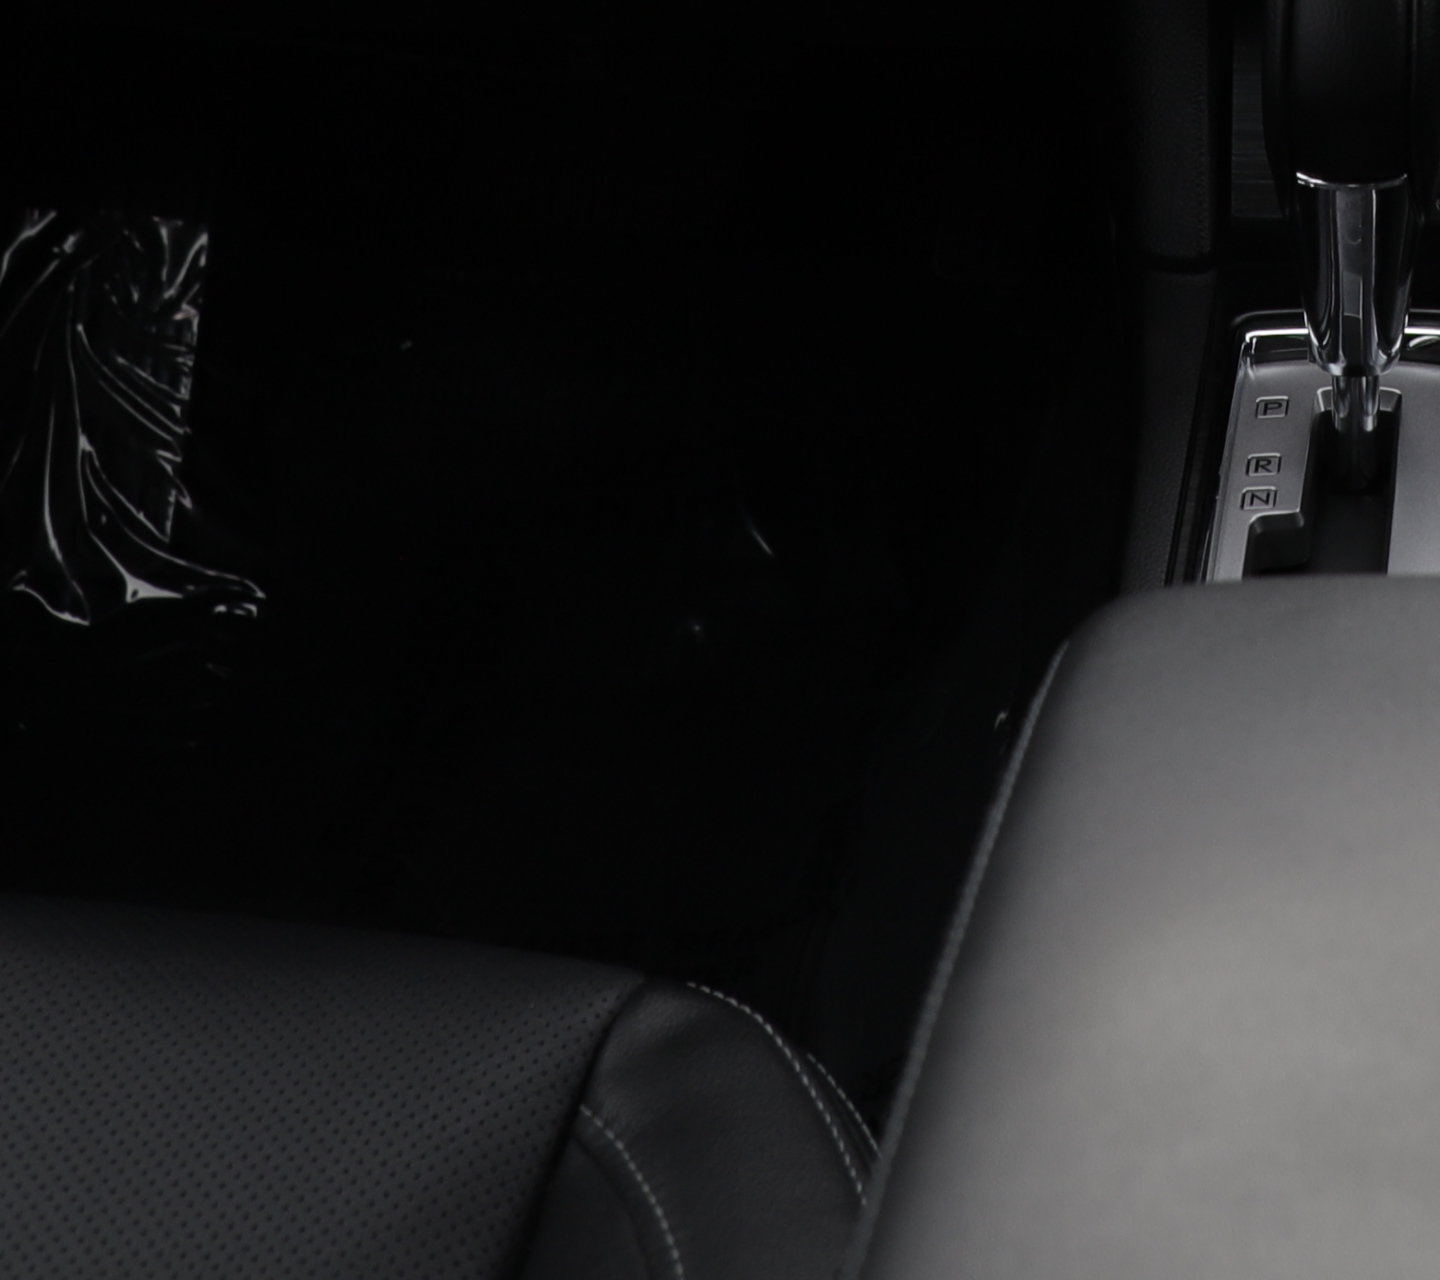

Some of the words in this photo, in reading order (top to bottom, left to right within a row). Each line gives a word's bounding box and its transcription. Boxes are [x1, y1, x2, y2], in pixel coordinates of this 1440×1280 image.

[1262, 401, 1283, 416] P
[1254, 458, 1273, 473] R
[1249, 491, 1271, 507] N
